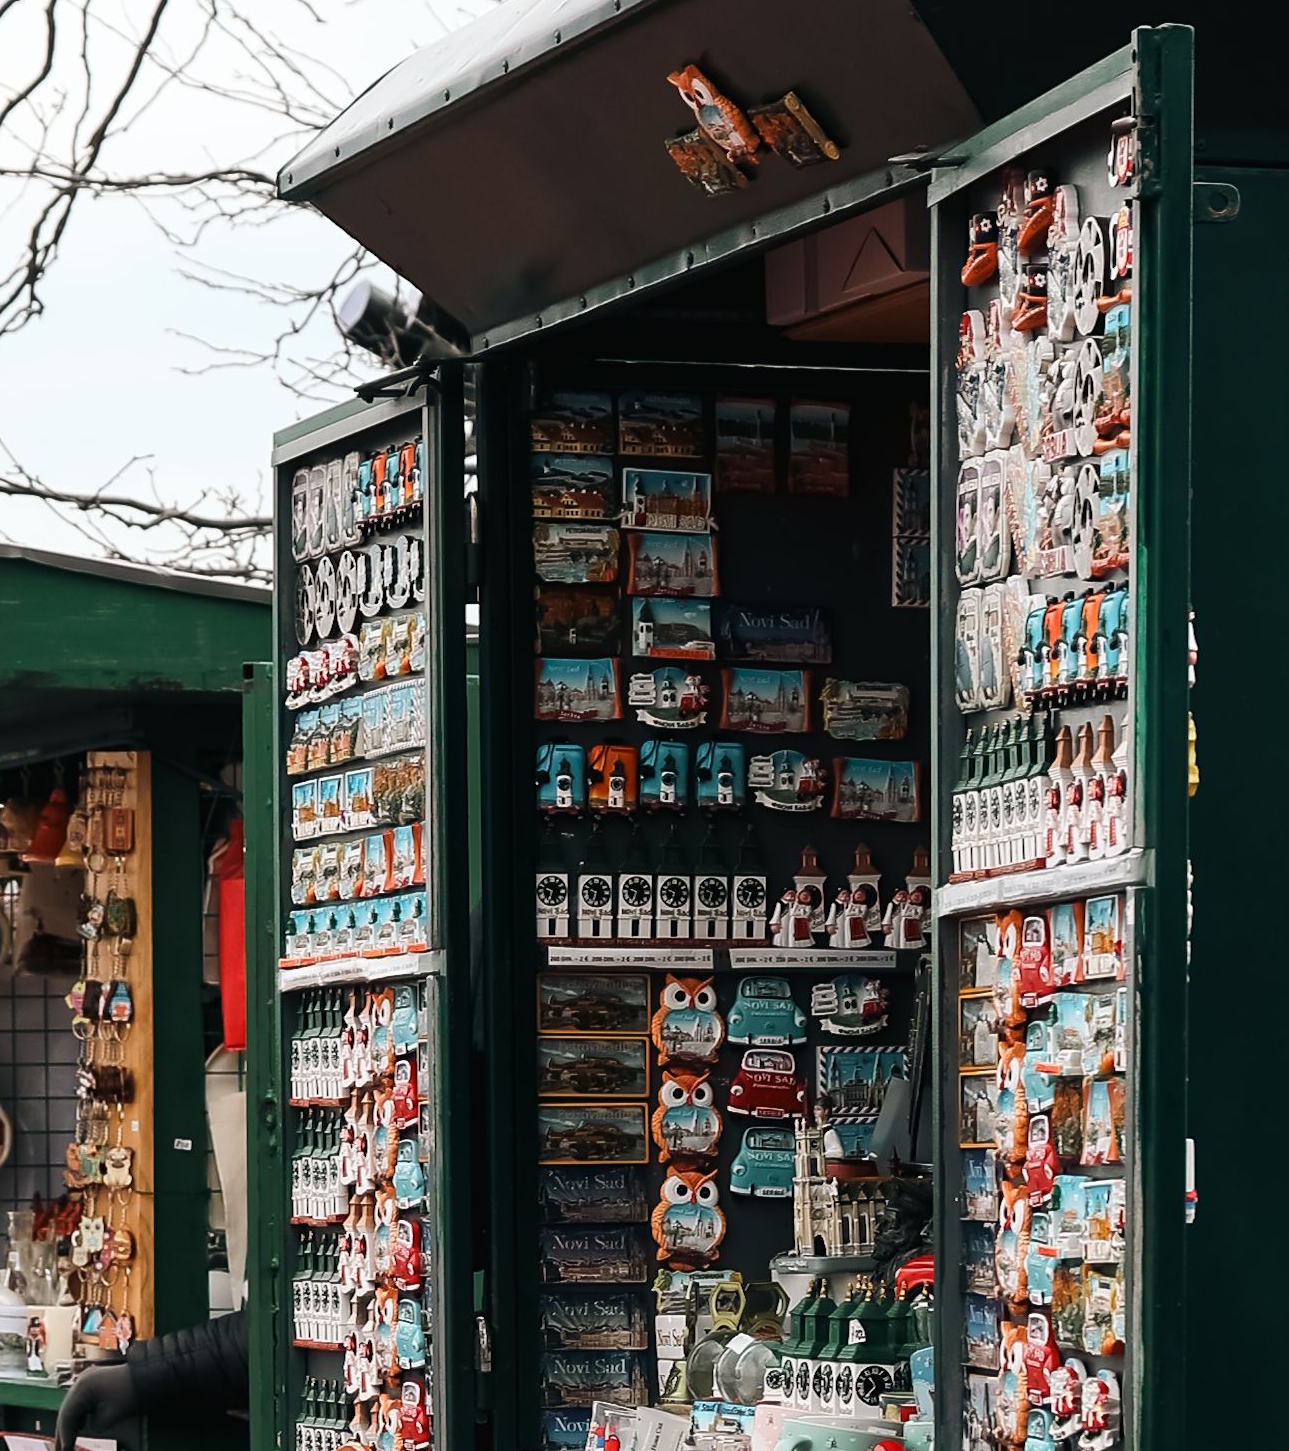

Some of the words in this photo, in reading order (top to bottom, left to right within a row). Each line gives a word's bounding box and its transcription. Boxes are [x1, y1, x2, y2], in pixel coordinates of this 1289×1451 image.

[739, 612, 774, 630] Novi
[779, 612, 811, 630] Sad
[552, 1173, 590, 1190] Novi
[594, 1172, 626, 1190] Sad
[552, 1234, 590, 1250] Novi
[593, 1233, 626, 1250] Sad
[551, 1300, 590, 1316] Novi
[593, 1299, 626, 1316] Sad
[553, 1358, 591, 1375] Novi
[594, 1357, 627, 1375] Sad
